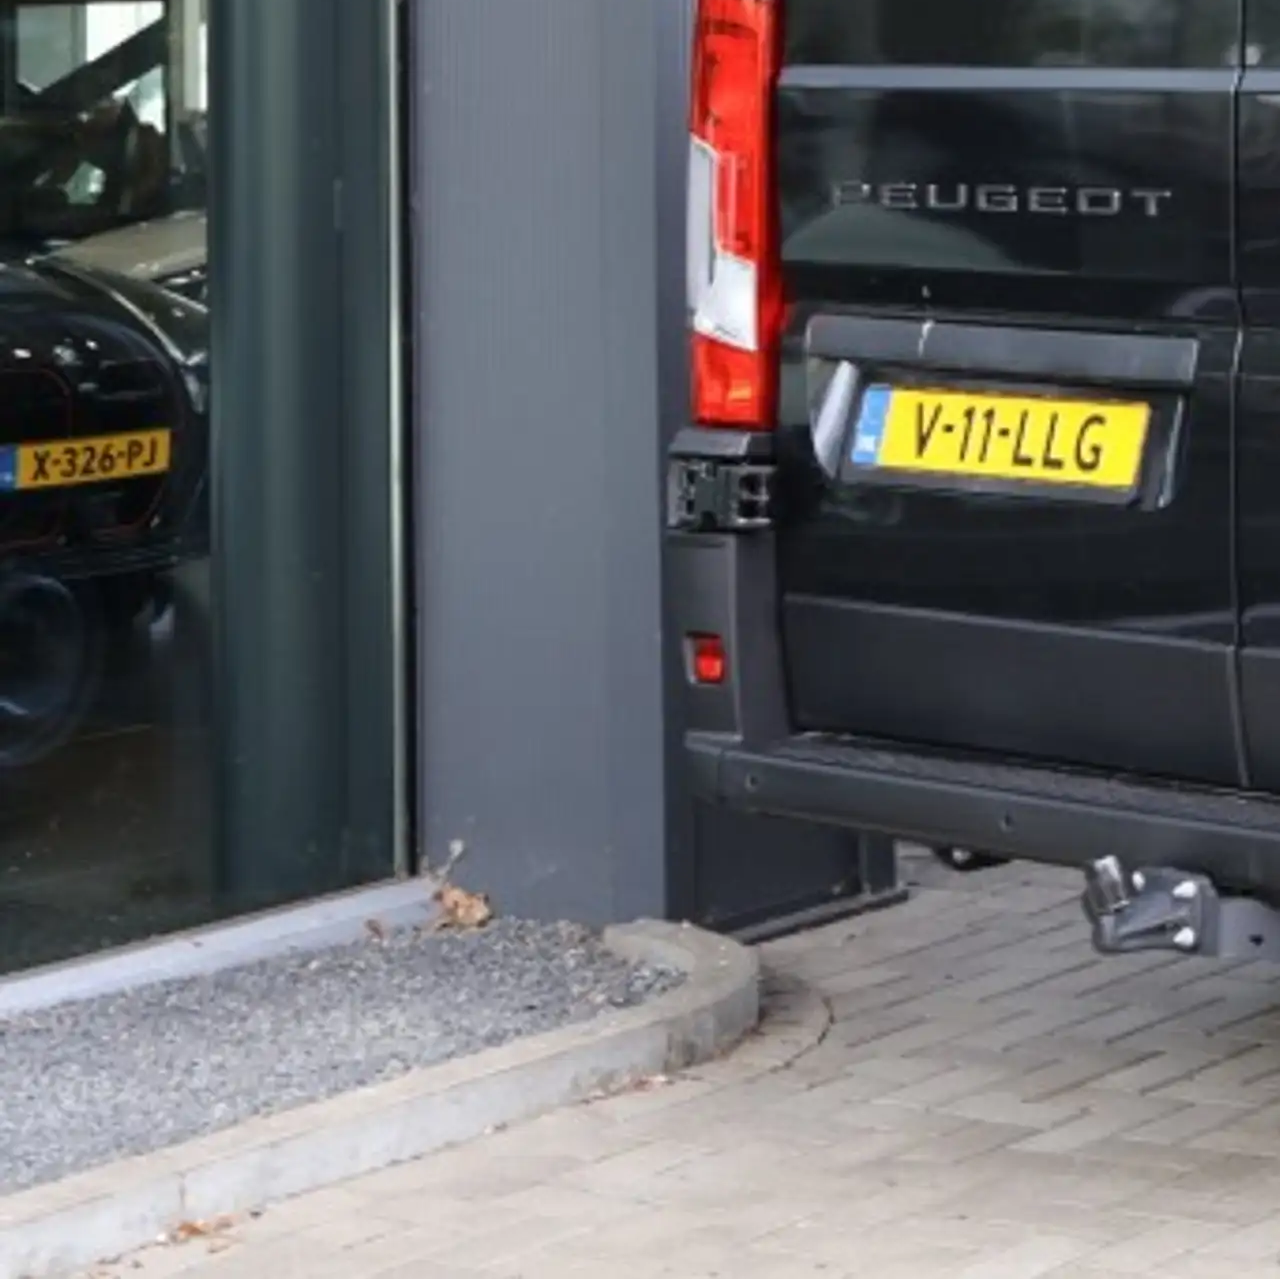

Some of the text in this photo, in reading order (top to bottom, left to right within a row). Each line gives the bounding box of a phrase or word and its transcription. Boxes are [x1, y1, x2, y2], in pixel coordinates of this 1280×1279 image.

[830, 181, 1173, 217] PEUGEOT
[32, 436, 158, 481] X-326-PJ
[914, 401, 1106, 472] V-11-LLG
